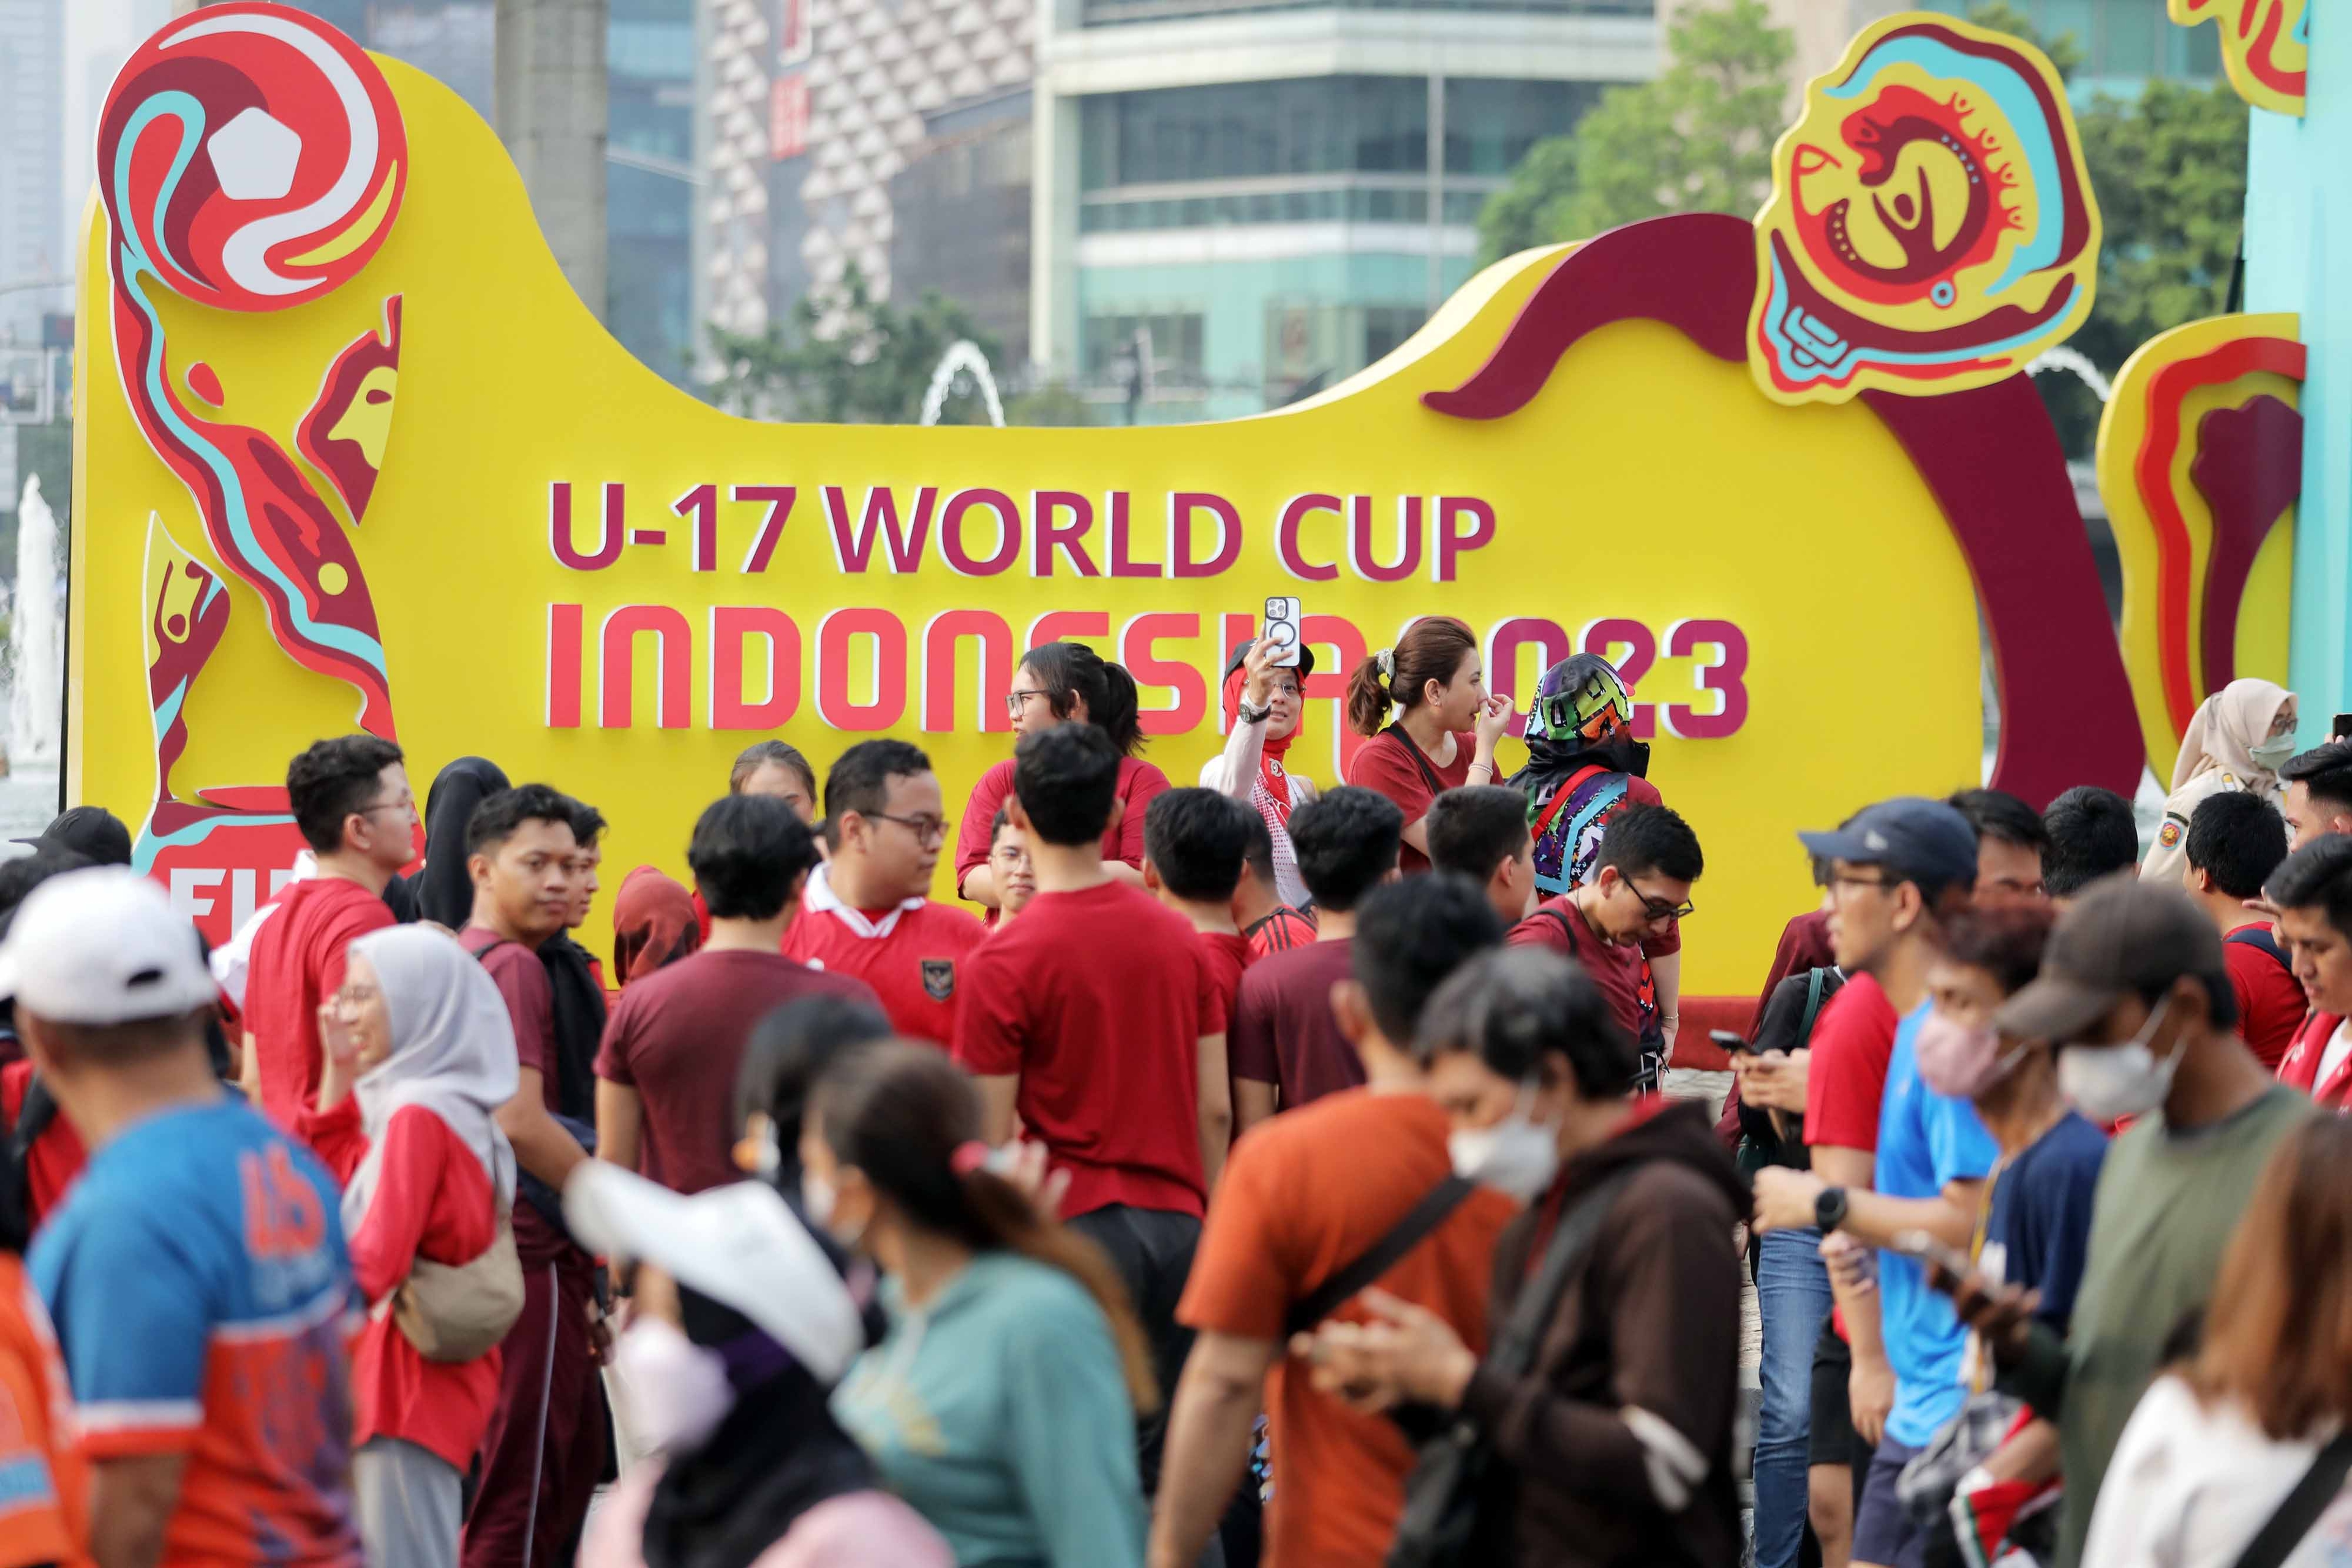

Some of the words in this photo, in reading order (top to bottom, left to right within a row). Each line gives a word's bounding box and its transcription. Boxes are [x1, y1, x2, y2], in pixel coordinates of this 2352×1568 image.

[549, 481, 797, 573] U-17
[819, 484, 1243, 579] WORLD
[1275, 493, 1496, 582] CUP
[1393, 615, 1749, 739] 023
